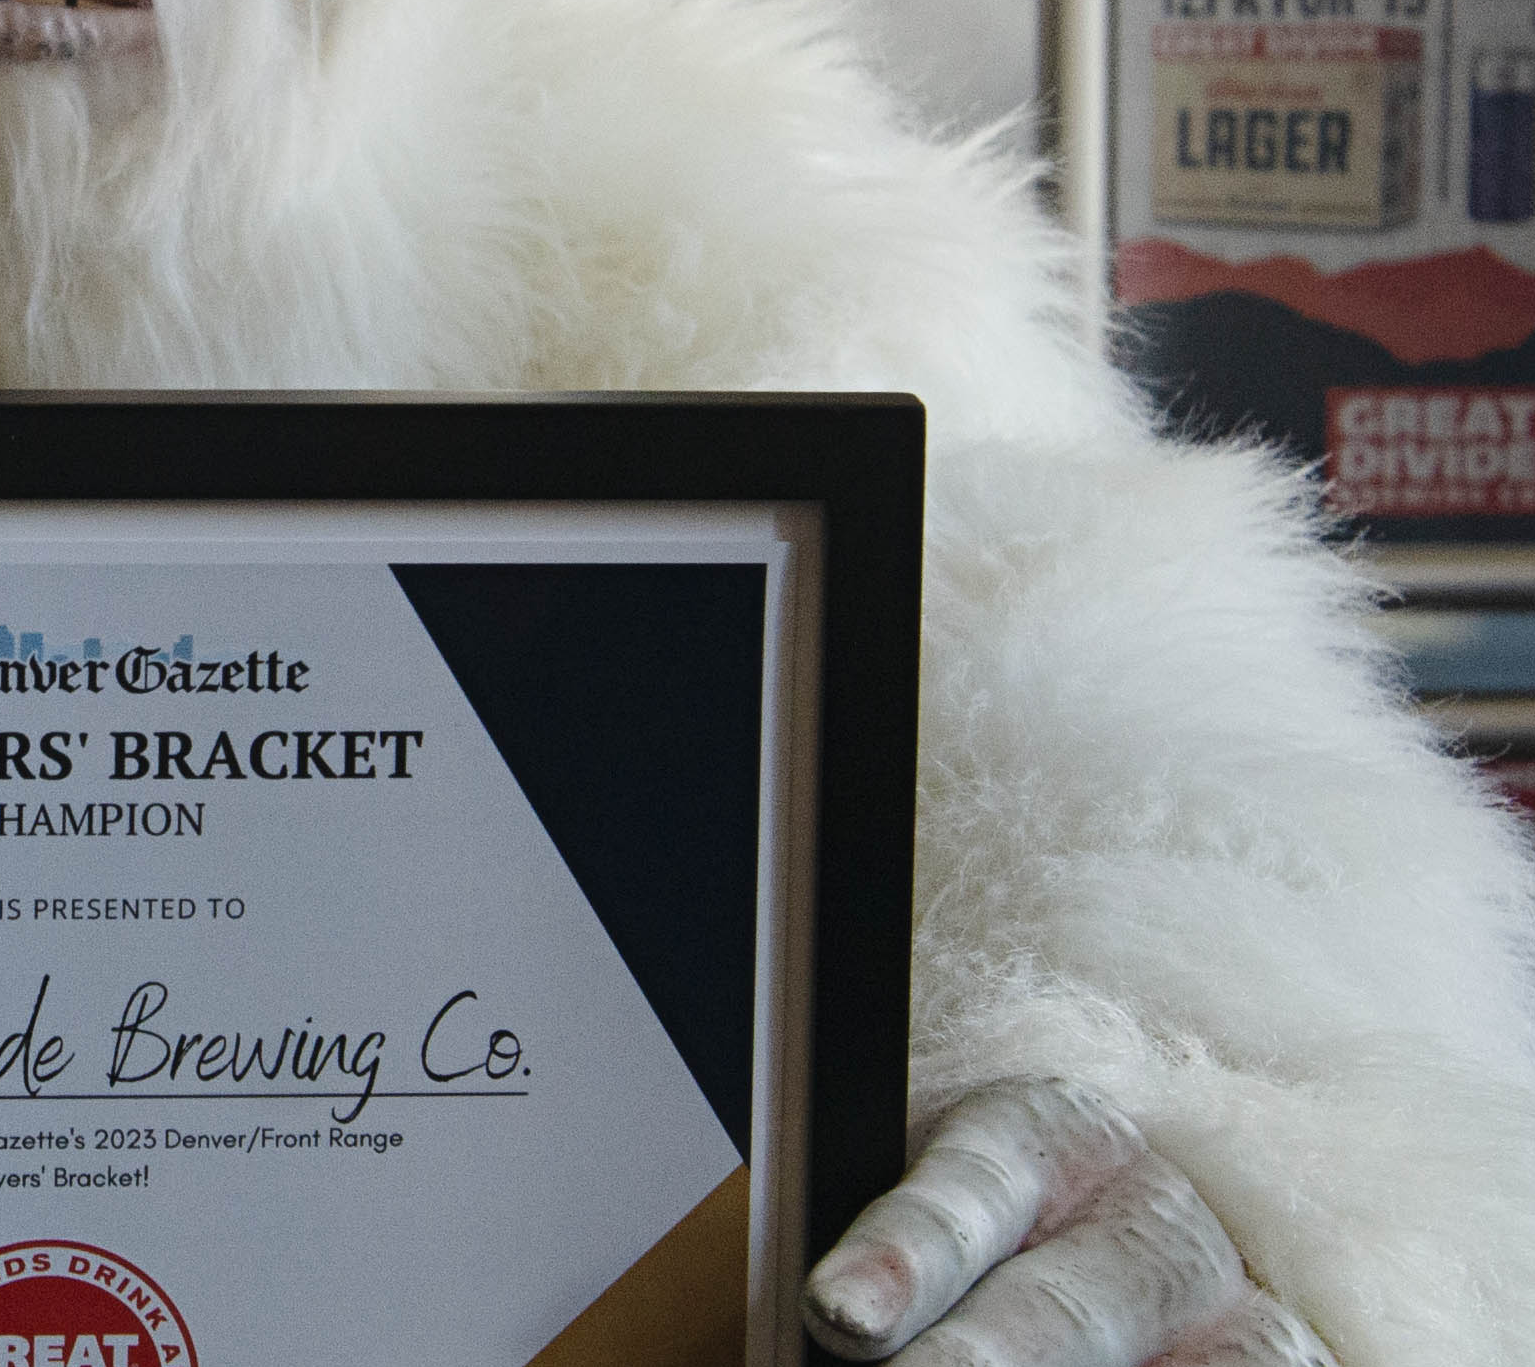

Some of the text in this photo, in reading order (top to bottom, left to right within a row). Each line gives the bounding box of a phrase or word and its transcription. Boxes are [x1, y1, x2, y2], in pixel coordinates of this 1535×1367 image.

[1176, 109, 1351, 173] LAGER
[116, 646, 310, 694] Gazette
[109, 729, 423, 781] BRACKET
[34, 898, 197, 921] PRESENTED
[207, 898, 246, 920] TO
[106, 981, 386, 1123] Brewing
[421, 991, 531, 1082] Co.
[95, 1129, 157, 1150] 2023
[164, 1126, 321, 1153] Denver/Front
[329, 1128, 404, 1153] Range
[54, 1165, 149, 1188] Bracket!
[69, 1255, 168, 1331] DRINK
